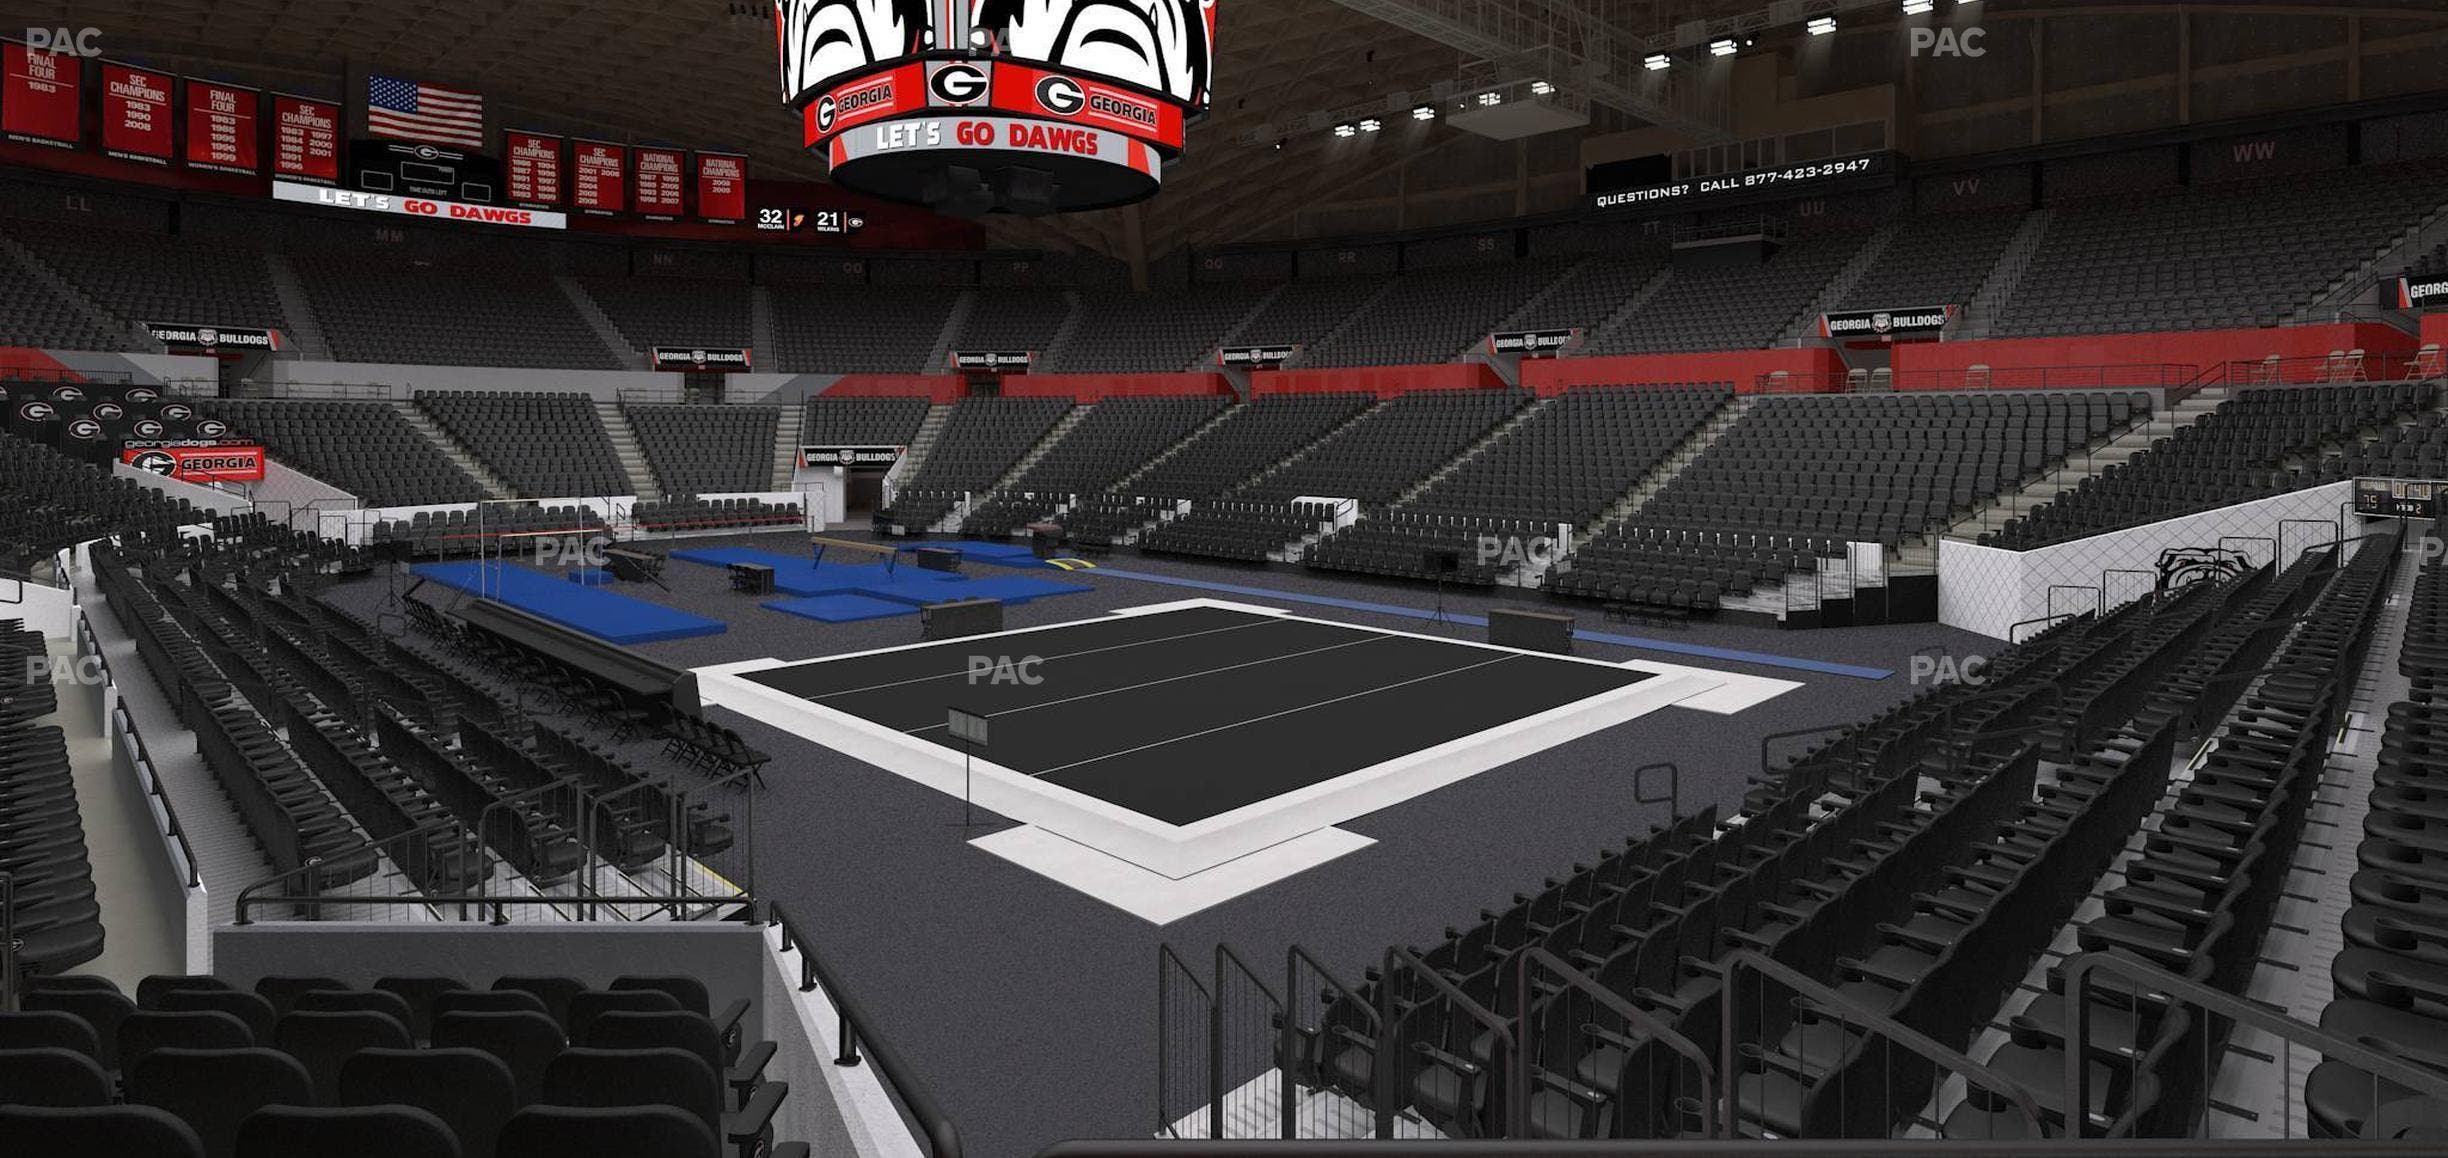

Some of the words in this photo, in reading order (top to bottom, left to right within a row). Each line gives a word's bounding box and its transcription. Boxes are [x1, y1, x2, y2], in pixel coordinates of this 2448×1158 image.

[27, 53, 57, 69] FINAL
[29, 64, 55, 80] FOUR
[128, 74, 147, 87] SEC
[930, 63, 990, 105] G
[28, 82, 57, 94] 1983
[110, 82, 165, 102] CHAMPIONS
[210, 89, 236, 103] FINAL
[1034, 75, 1086, 116] G
[1089, 94, 1157, 125] GEORGIA
[126, 100, 151, 111] 1983
[211, 100, 235, 113] FOUR
[299, 104, 315, 117] SEC
[817, 94, 837, 134] G
[838, 84, 893, 114] GEORGIA
[281, 112, 332, 129] CHAMPIONS
[309, 139, 332, 149] 2000
[528, 139, 541, 149] SEC
[876, 121, 941, 150] LET'S
[956, 121, 995, 146] GO
[1009, 123, 1098, 155] DAWGS
[309, 148, 332, 157] 2001
[513, 146, 555, 160] CHAMPIONS
[2232, 142, 2276, 164] WW
[1597, 184, 1689, 207] QUESTIONS?
[1700, 178, 1740, 193] CALL
[1744, 159, 1870, 186] 877-423-2947
[319, 188, 391, 210] LET'S
[404, 199, 438, 216] GO
[450, 205, 532, 225] DAWGS
[759, 208, 783, 224] 32
[817, 211, 838, 226] 21
[1830, 318, 1871, 331] GEORGIA
[1893, 314, 1945, 328] BULLDOGS
[219, 333, 268, 345] BULLDOGS
[1496, 338, 1524, 348] GEORGIA
[659, 352, 691, 361] GEORGIA
[707, 353, 743, 362] BULLDOGS
[124, 439, 255, 448] georgiadogs.com
[182, 457, 256, 469] GEORGIA
[806, 453, 838, 462] GEORGIA
[856, 453, 896, 462] BULLDOGS
